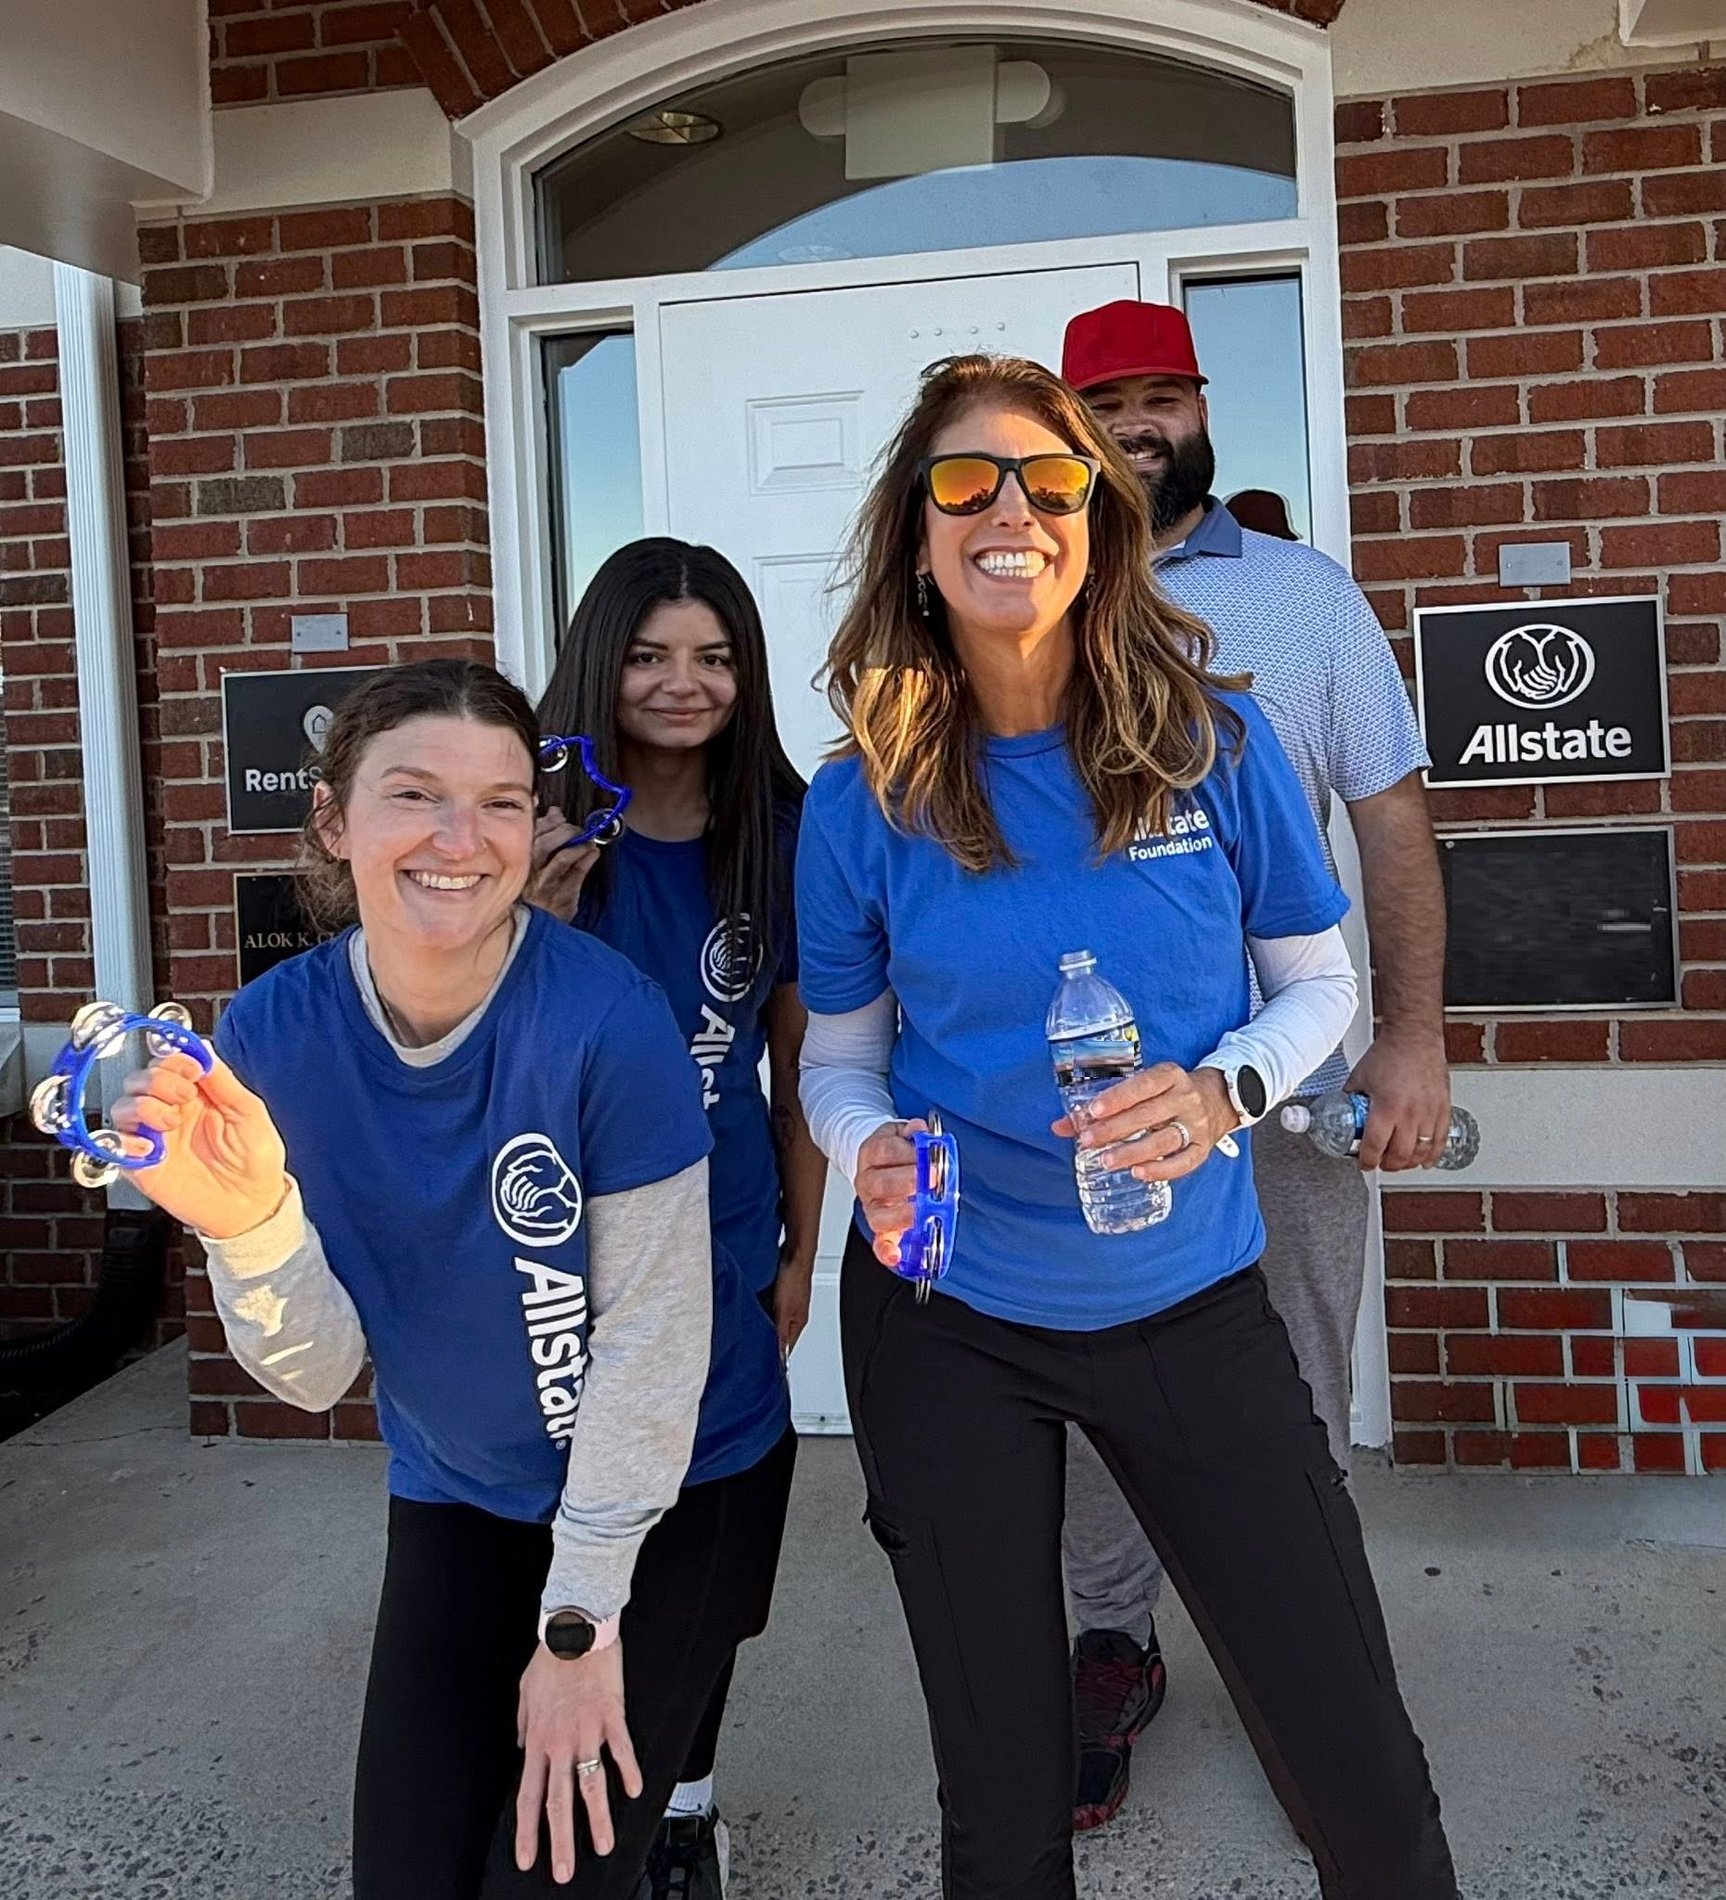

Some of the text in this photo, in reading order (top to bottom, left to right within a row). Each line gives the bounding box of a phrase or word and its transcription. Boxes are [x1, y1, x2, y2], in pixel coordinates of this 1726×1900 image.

[1459, 719, 1633, 766] Allstate
[245, 766, 323, 792] RentS
[1128, 836, 1213, 862] Foundation
[244, 932, 294, 949] ALOK
